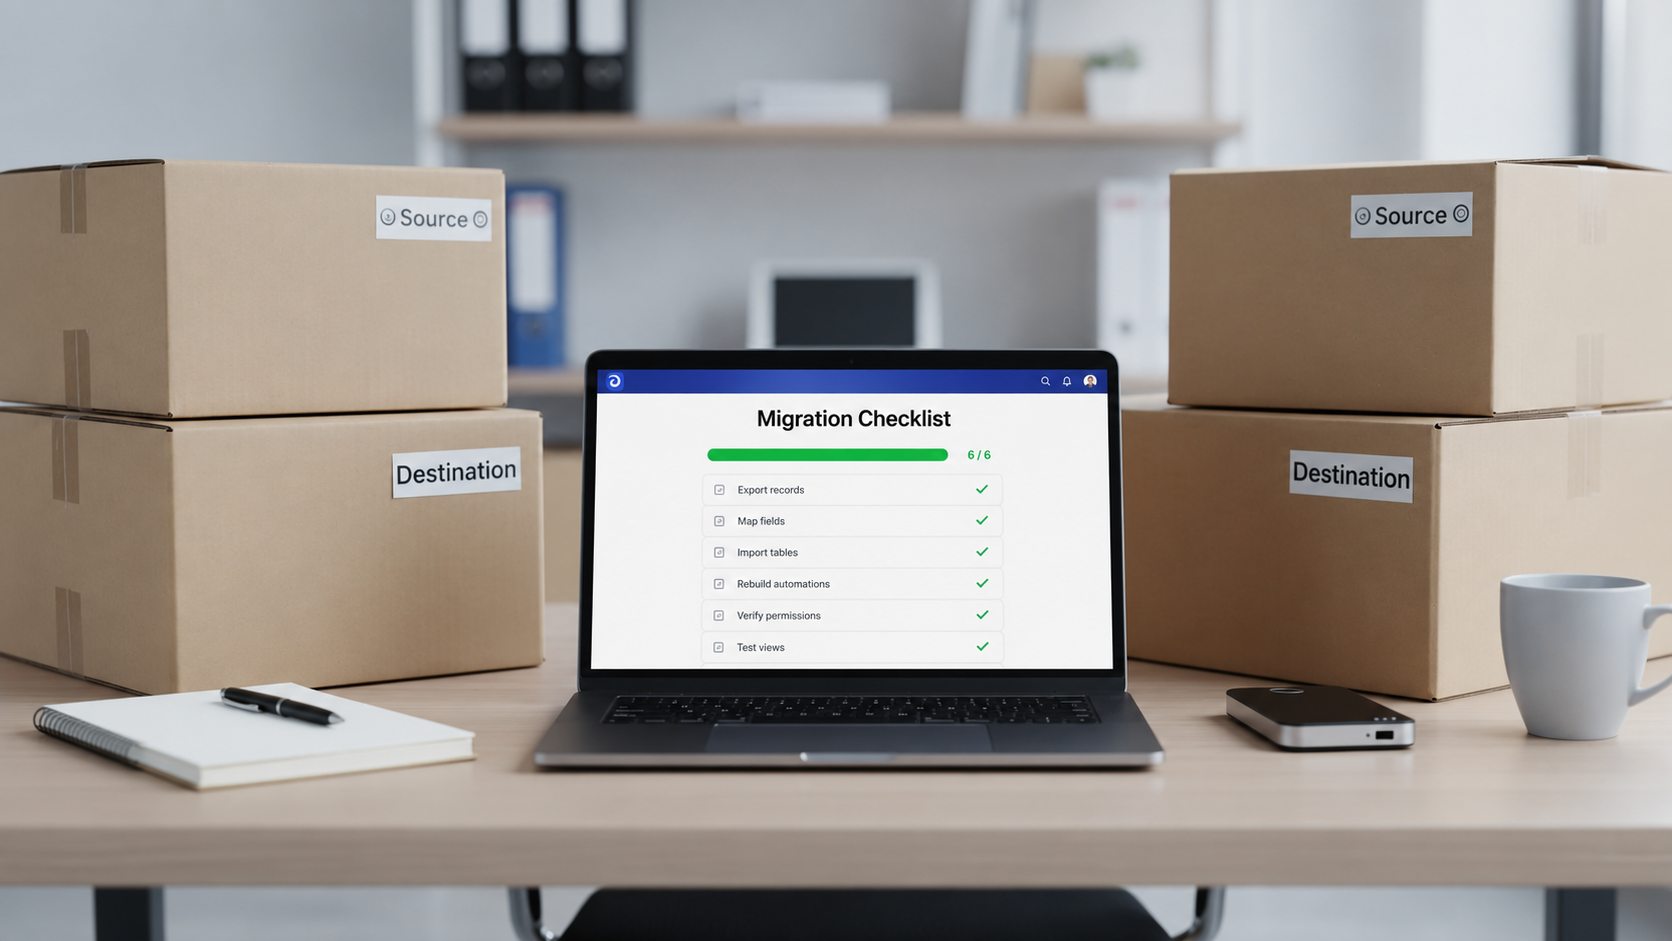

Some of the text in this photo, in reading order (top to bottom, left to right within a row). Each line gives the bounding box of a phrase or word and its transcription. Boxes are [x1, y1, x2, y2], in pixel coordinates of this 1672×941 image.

[400, 208, 468, 228] Source
[1375, 206, 1448, 226] Source
[757, 408, 952, 432] Migration Checklist
[397, 460, 516, 485] Destination
[1293, 461, 1410, 490] Destination
[737, 485, 805, 497] Export records
[737, 516, 786, 528] Map fields
[737, 547, 799, 559] Import tables
[736, 579, 831, 589] Rebuild automations
[736, 611, 822, 623] Verify permissions
[736, 642, 786, 652] Test views
